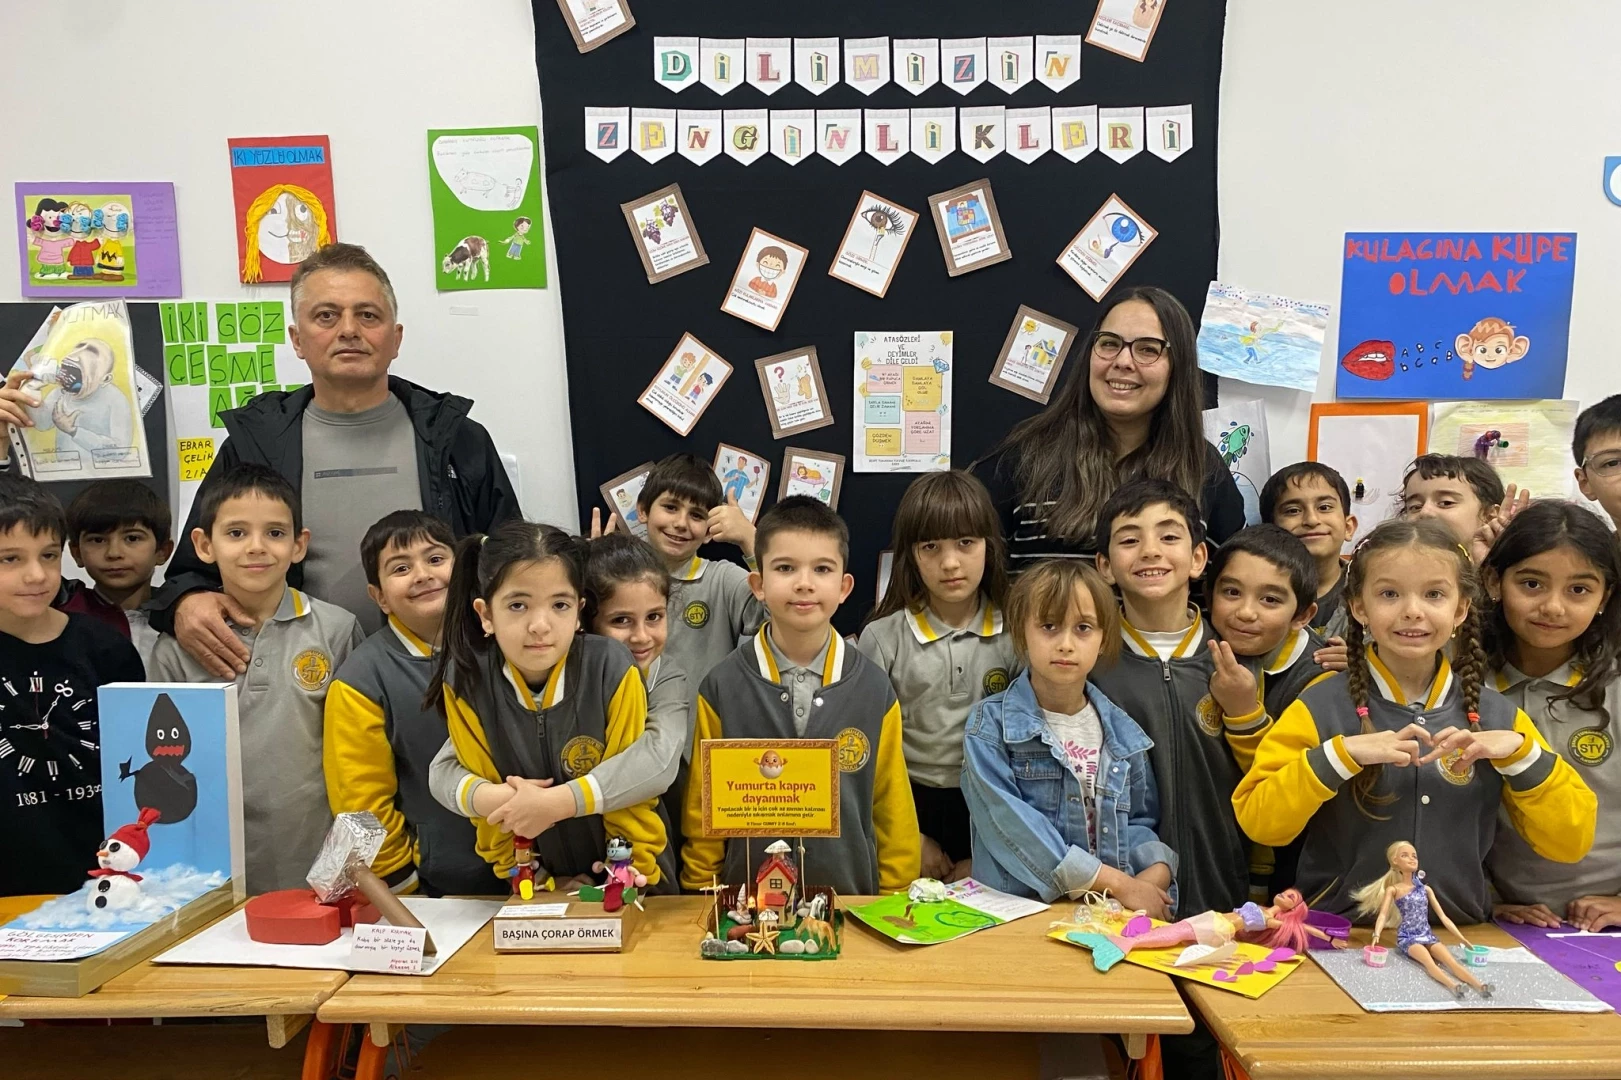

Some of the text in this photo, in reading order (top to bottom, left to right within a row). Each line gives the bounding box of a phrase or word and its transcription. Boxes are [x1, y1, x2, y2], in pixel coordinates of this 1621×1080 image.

[1388, 268, 1527, 296] OLMAK
[167, 306, 284, 342] İKİ GÖZ
[169, 350, 275, 385] ÇEŞME
[179, 440, 212, 451] EBRAR
[184, 451, 214, 464] ÇELİK
[1579, 743, 1603, 754] STY
[726, 780, 816, 793] Yumurta kapıya
[742, 793, 800, 805] dayanmak
[502, 927, 615, 941] BAŞINA ÇORAP ÖRMEK
